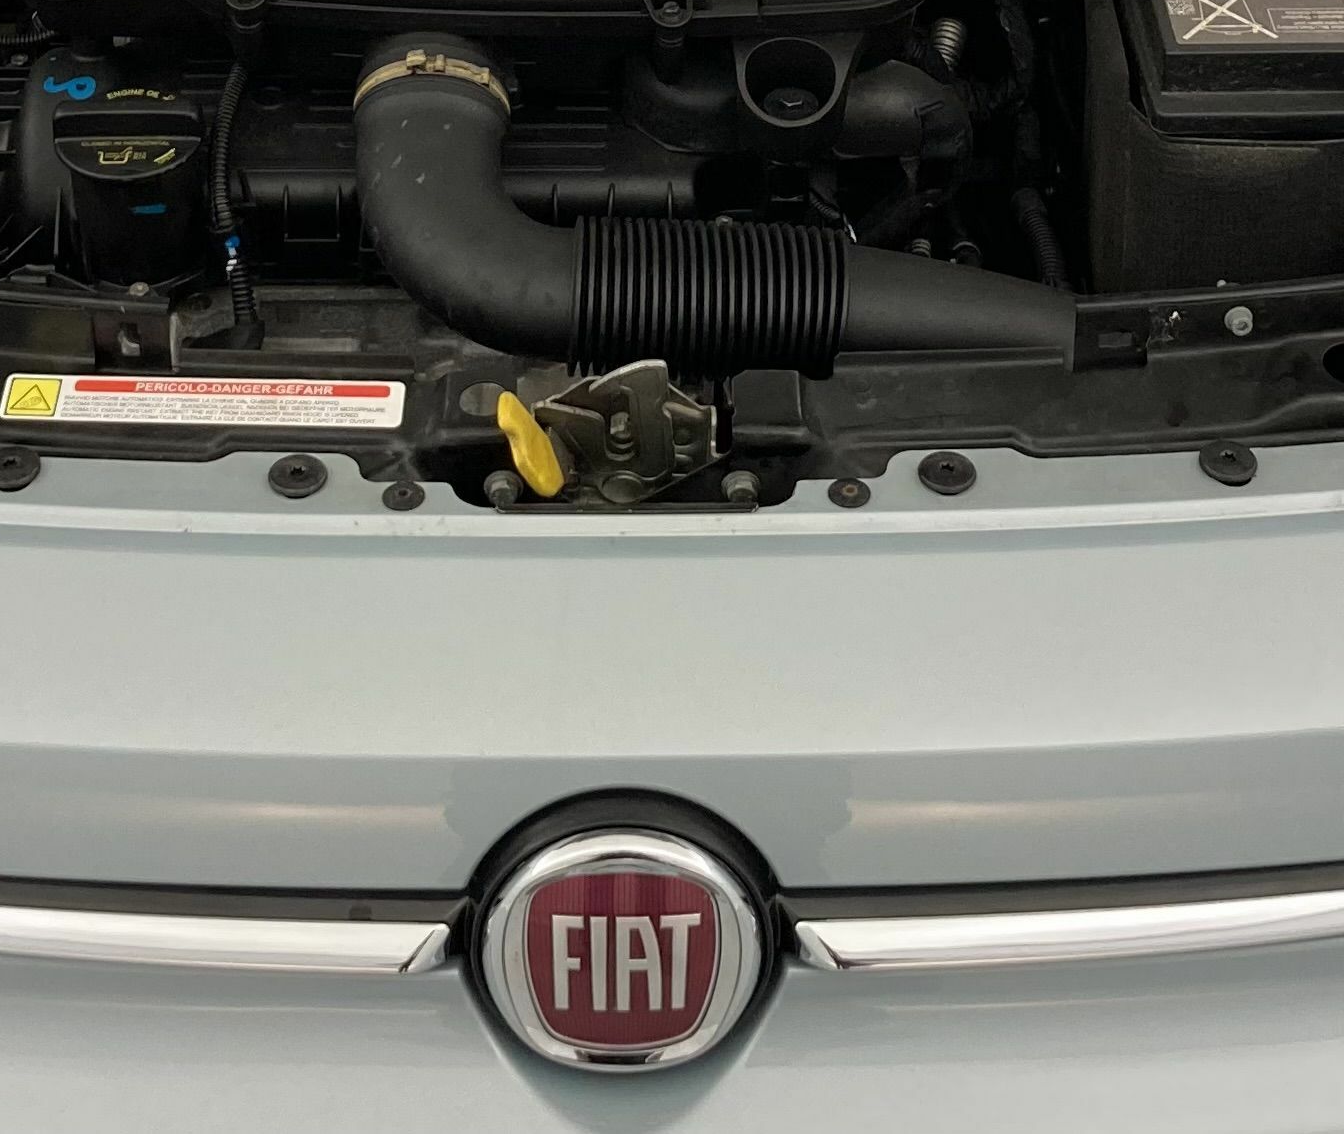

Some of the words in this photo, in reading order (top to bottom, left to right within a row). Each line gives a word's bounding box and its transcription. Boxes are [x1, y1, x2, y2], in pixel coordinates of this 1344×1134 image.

[105, 88, 145, 101] ENGINE
[135, 382, 334, 396] PERICOLO-DANGER-GEFAHR
[551, 912, 701, 1012] FIAT
